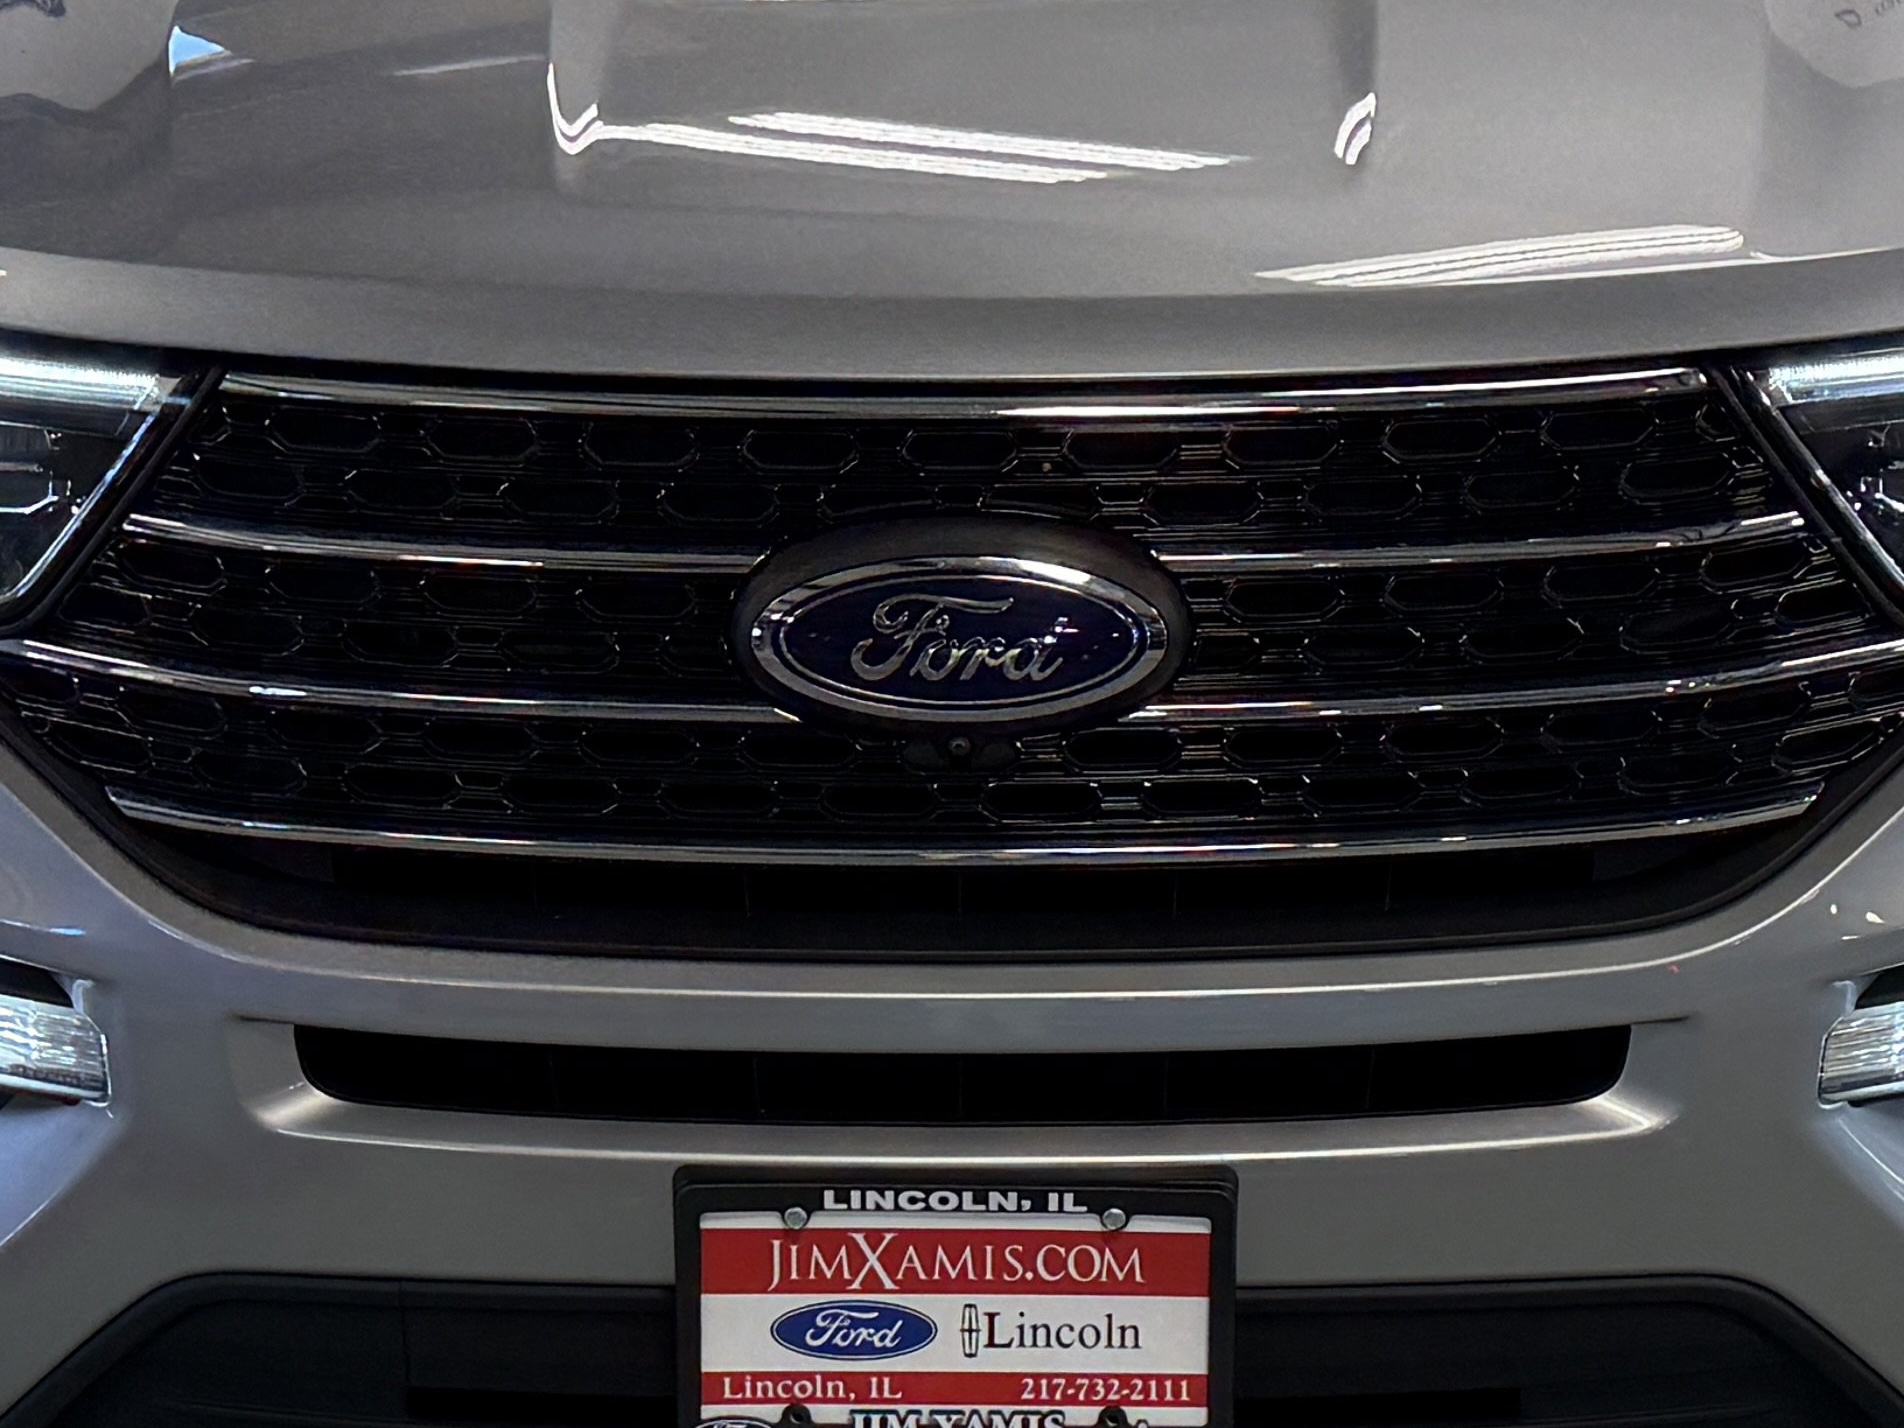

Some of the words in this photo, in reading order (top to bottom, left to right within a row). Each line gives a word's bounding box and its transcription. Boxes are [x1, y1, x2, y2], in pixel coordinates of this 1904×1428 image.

[850, 594, 1069, 682] Ford
[823, 1189, 1032, 1213] LINCOLN,
[1047, 1191, 1088, 1213] IL
[767, 1232, 1146, 1291] JIMXAMIS.COM
[804, 1308, 904, 1349] Ford
[983, 1311, 1143, 1350] Lincoln
[722, 1375, 856, 1401] Lincoln,
[869, 1377, 903, 1399] IL
[1020, 1377, 1191, 1402] 217-732-2111
